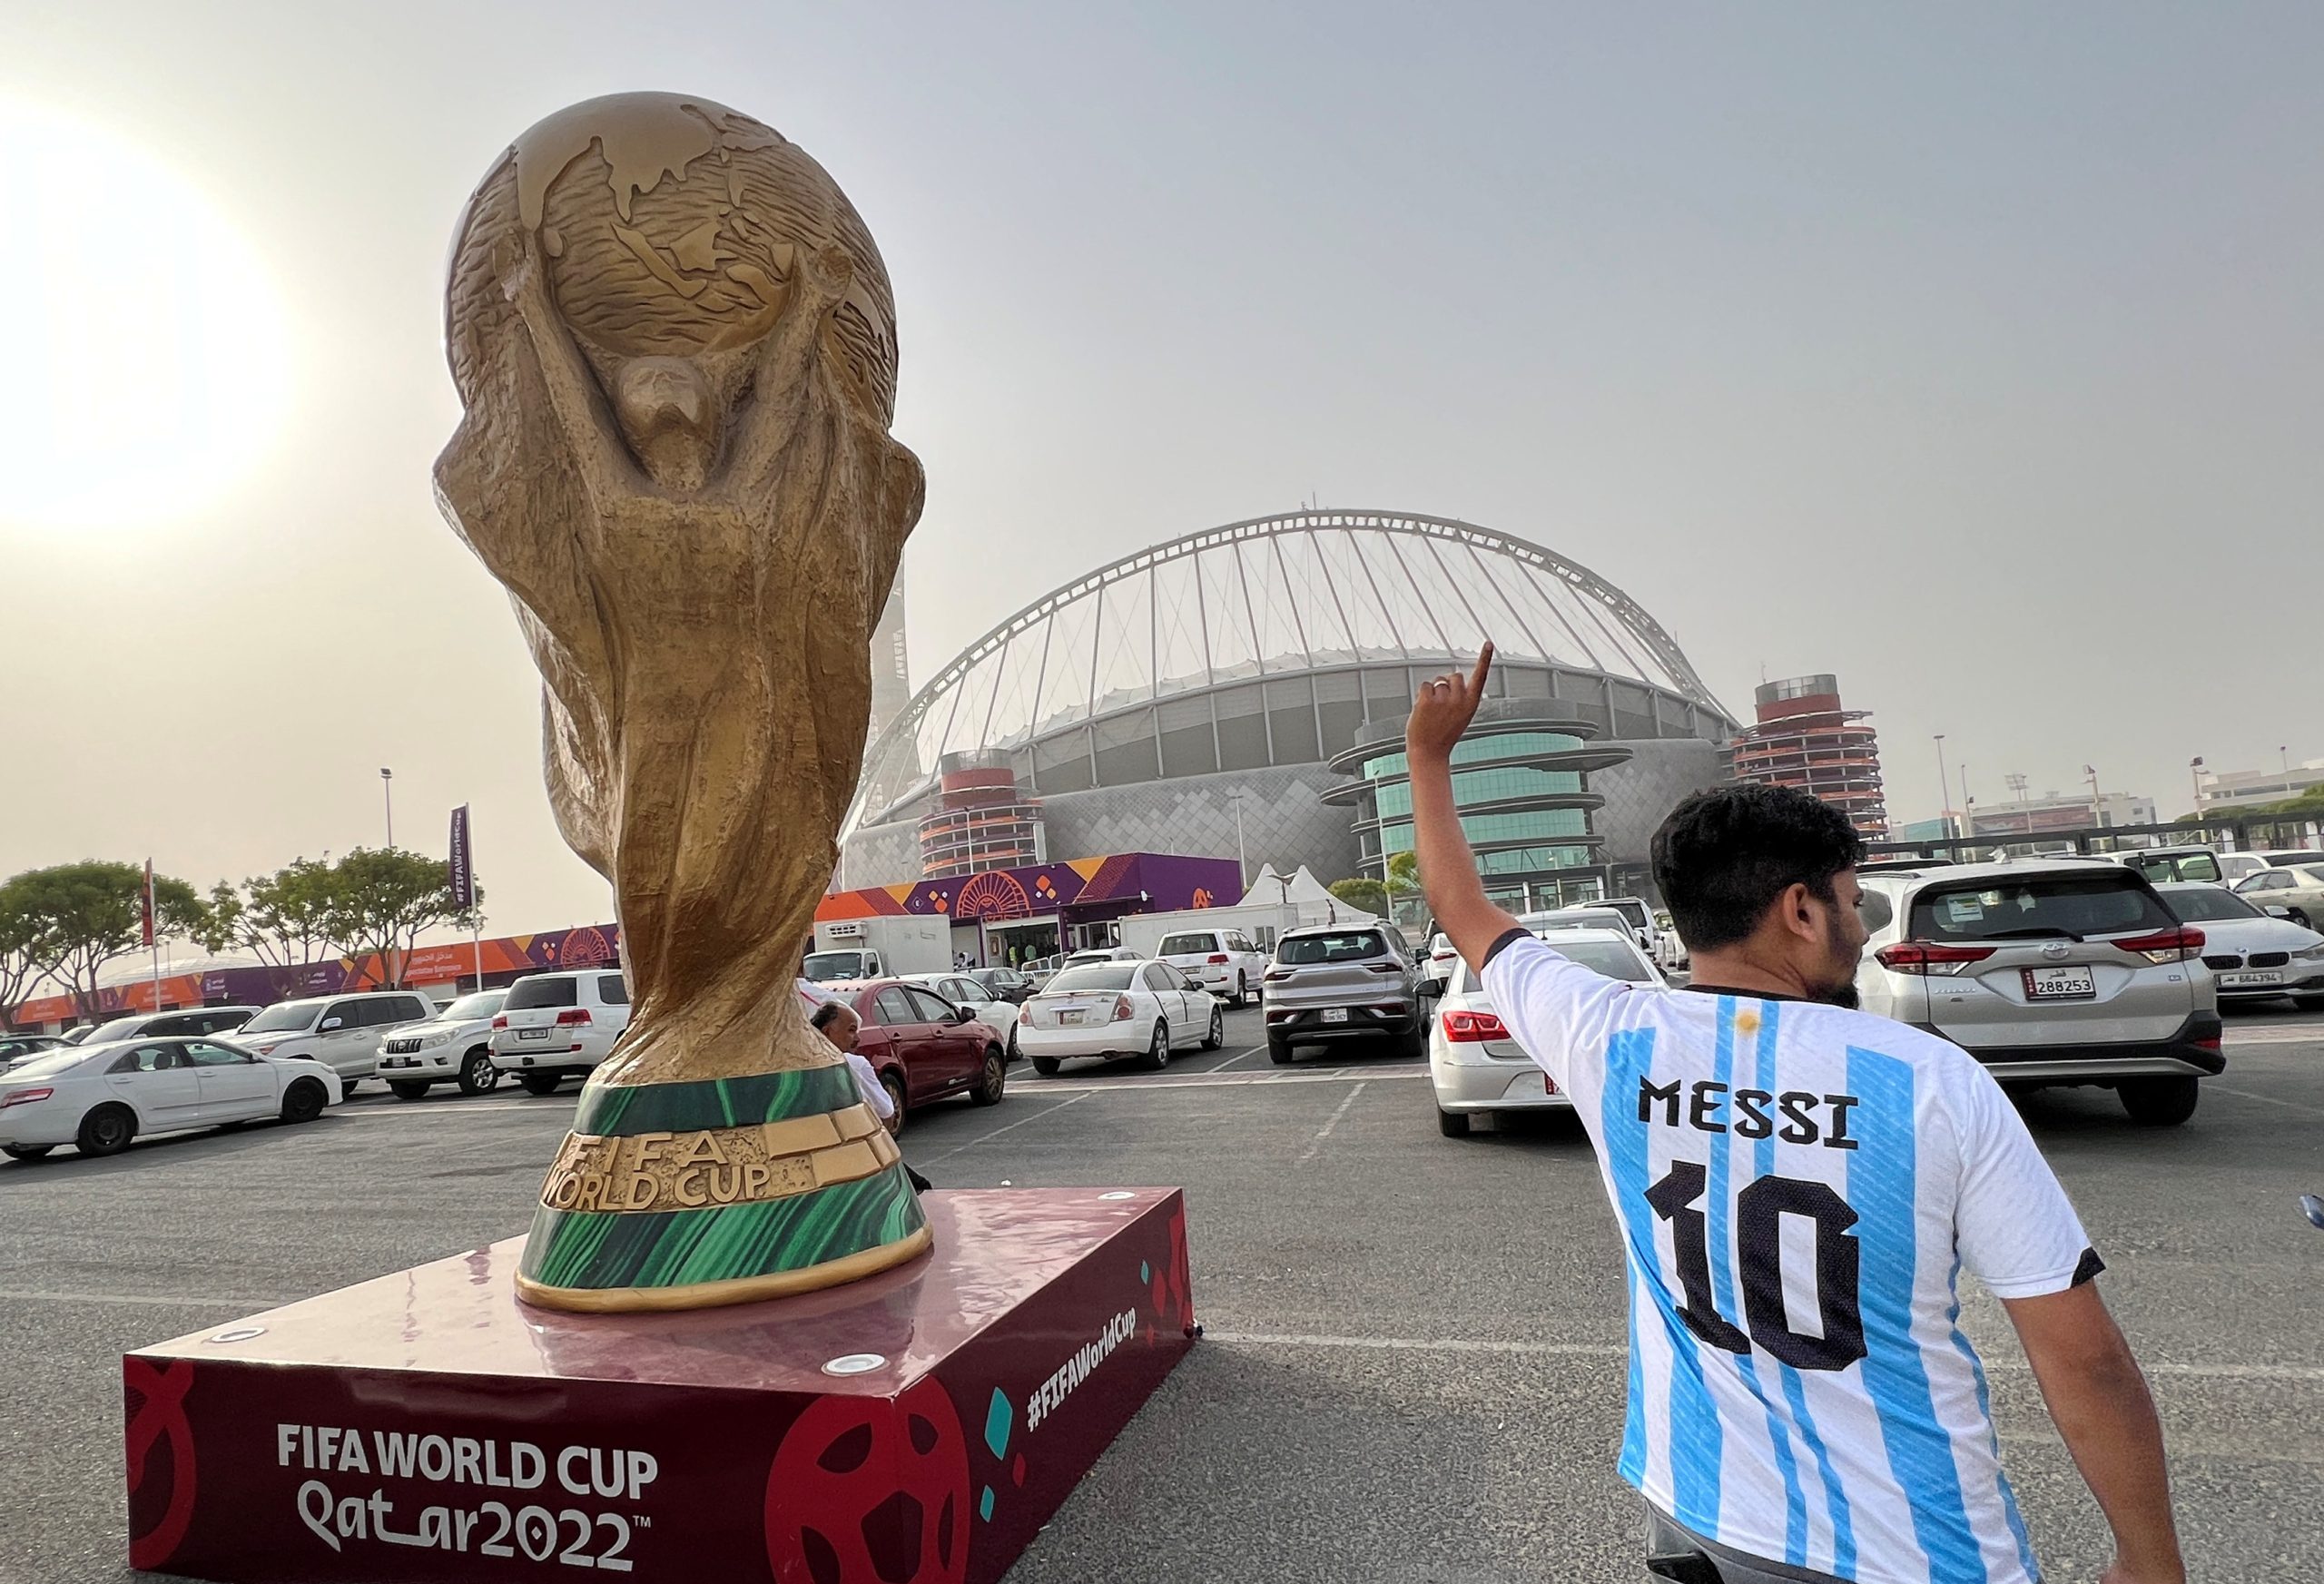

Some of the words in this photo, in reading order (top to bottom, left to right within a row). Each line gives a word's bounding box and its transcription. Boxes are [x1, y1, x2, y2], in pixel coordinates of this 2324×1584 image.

[2037, 979, 2092, 994] 288253
[1638, 1075, 1859, 1150] MESSI
[543, 1163, 660, 1211] WORLD
[674, 1164, 771, 1206] CUP
[568, 1129, 729, 1172] FIFA
[1643, 1159, 1868, 1372] 10
[1028, 1306, 1137, 1433] #FIFAWorldCup
[277, 1423, 369, 1474] FIFA
[373, 1431, 547, 1489] WORLD
[556, 1445, 658, 1500] CUP
